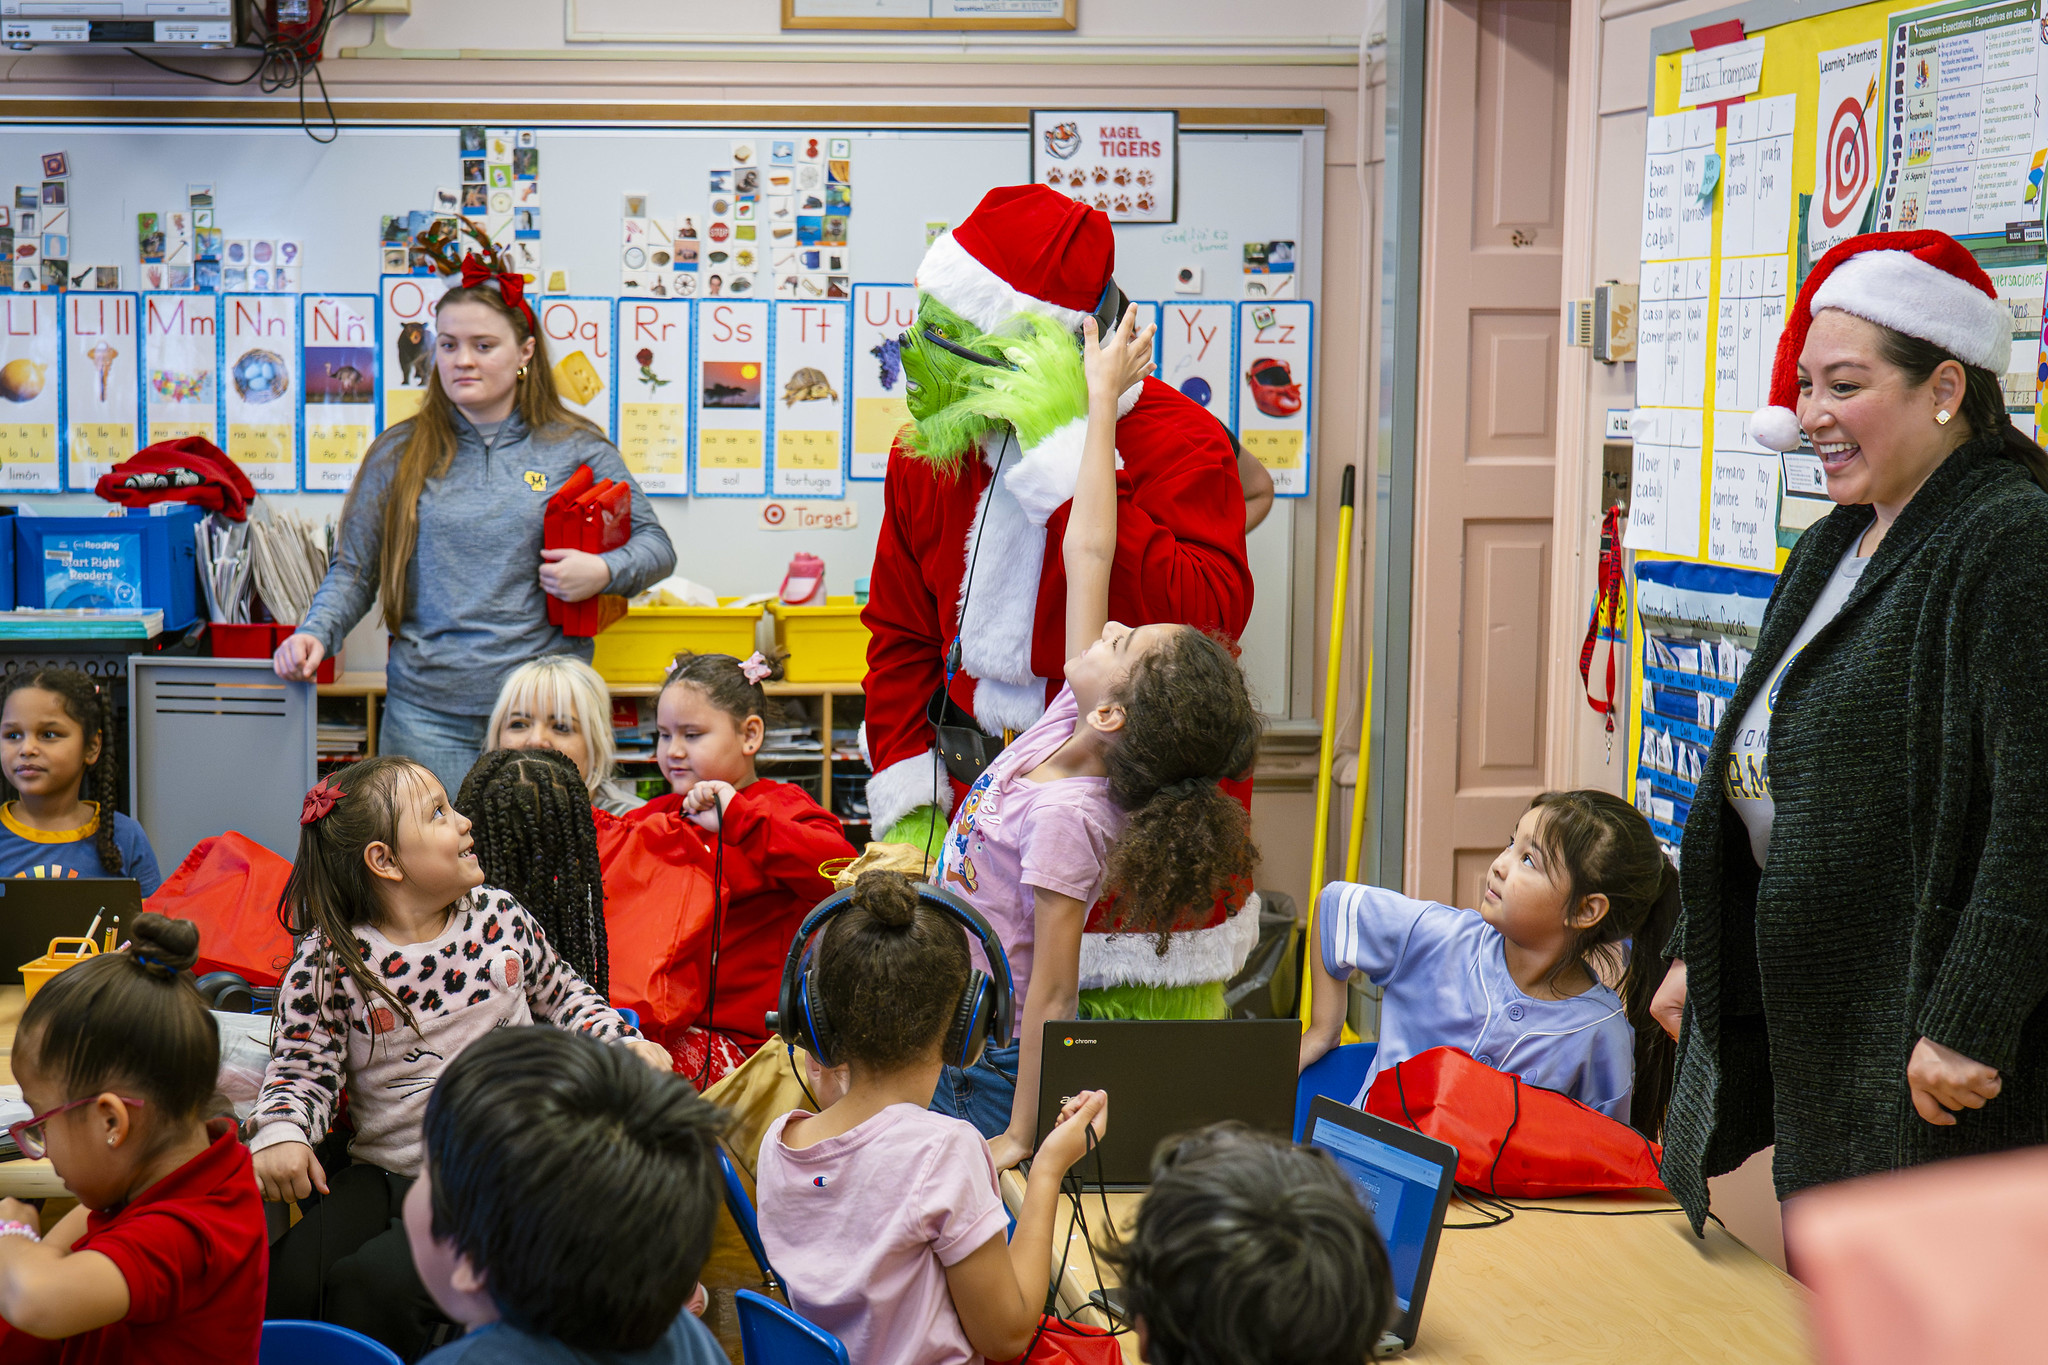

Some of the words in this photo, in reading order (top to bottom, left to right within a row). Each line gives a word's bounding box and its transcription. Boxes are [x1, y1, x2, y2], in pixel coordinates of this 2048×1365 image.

[1942, 18, 1972, 33] Expectations
[1976, 11, 2006, 26] Expectativas
[2006, 11, 2013, 19] en
[2014, 8, 2027, 18] clase
[1820, 57, 1846, 74] Learning
[1847, 48, 1878, 66] Intentions
[1916, 46, 1937, 57] Responsable
[1686, 63, 1711, 92] Letras
[1716, 57, 1758, 91] Tramposas
[1100, 127, 1142, 139] KAGEL
[1100, 141, 1161, 157] TIGERS
[1759, 140, 1782, 172] jirafa
[1649, 181, 1669, 199] bien
[1758, 174, 1774, 200] joya
[2009, 232, 2022, 240] BLOCK
[2026, 230, 2042, 238] POSTERS
[1992, 272, 2044, 288] nversaciones.
[149, 299, 214, 335] Mm
[236, 300, 285, 336] Nn
[865, 291, 913, 326] Uu
[313, 300, 365, 341] Ññ
[544, 304, 607, 358] Qq
[635, 306, 676, 341] Rr
[713, 306, 752, 342] Ss
[791, 307, 831, 343] Tt
[1178, 308, 1217, 361] Yy
[9, 468, 40, 480] limón
[249, 468, 274, 480] nido
[722, 472, 740, 485] sol
[785, 474, 831, 492] tortuga
[1716, 460, 1746, 481] hermano
[1758, 464, 1770, 497] hoy
[793, 507, 851, 528] Target
[1634, 508, 1655, 527] llave
[1712, 513, 1720, 530] he
[85, 541, 120, 551] Reading
[90, 557, 120, 569] Right
[70, 570, 113, 580] Readers
[1720, 605, 1748, 636] Cards
